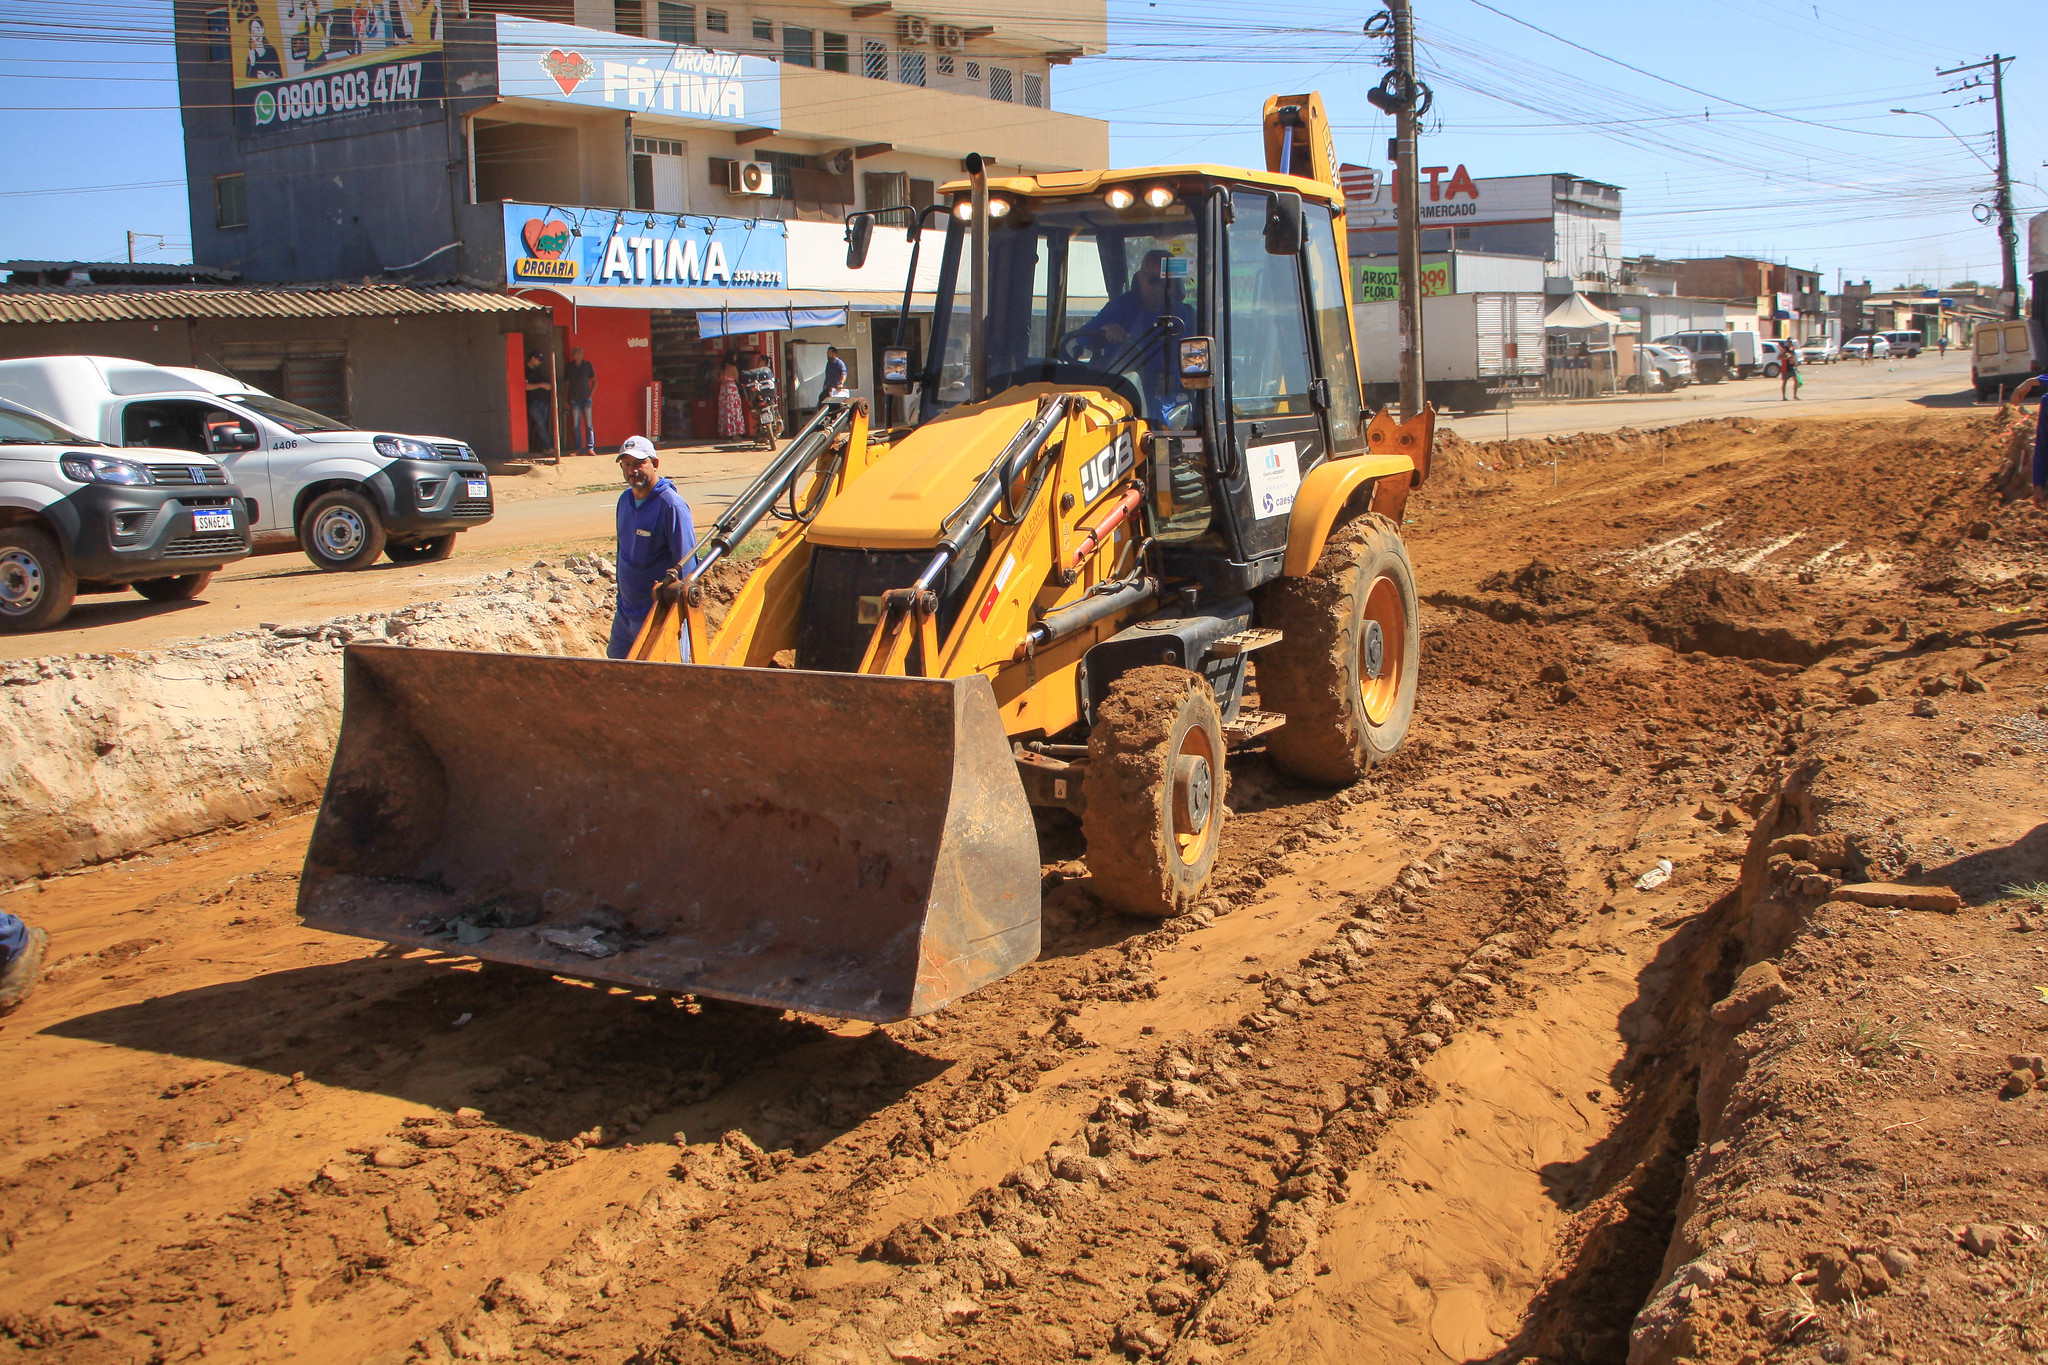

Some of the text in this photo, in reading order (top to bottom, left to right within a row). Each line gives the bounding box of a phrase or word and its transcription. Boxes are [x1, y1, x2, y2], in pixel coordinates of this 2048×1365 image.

[673, 48, 743, 79] DROGARIA
[278, 61, 423, 122] 0800 603 4747
[603, 57, 745, 120] FÁTIMA
[522, 259, 575, 277] DROGARIA
[1362, 270, 1399, 286] ARROZ
[1363, 286, 1395, 299] FLORA
[273, 440, 298, 451] 4406
[1080, 431, 1135, 503] JCB
[1016, 498, 1047, 552] VALENCE
